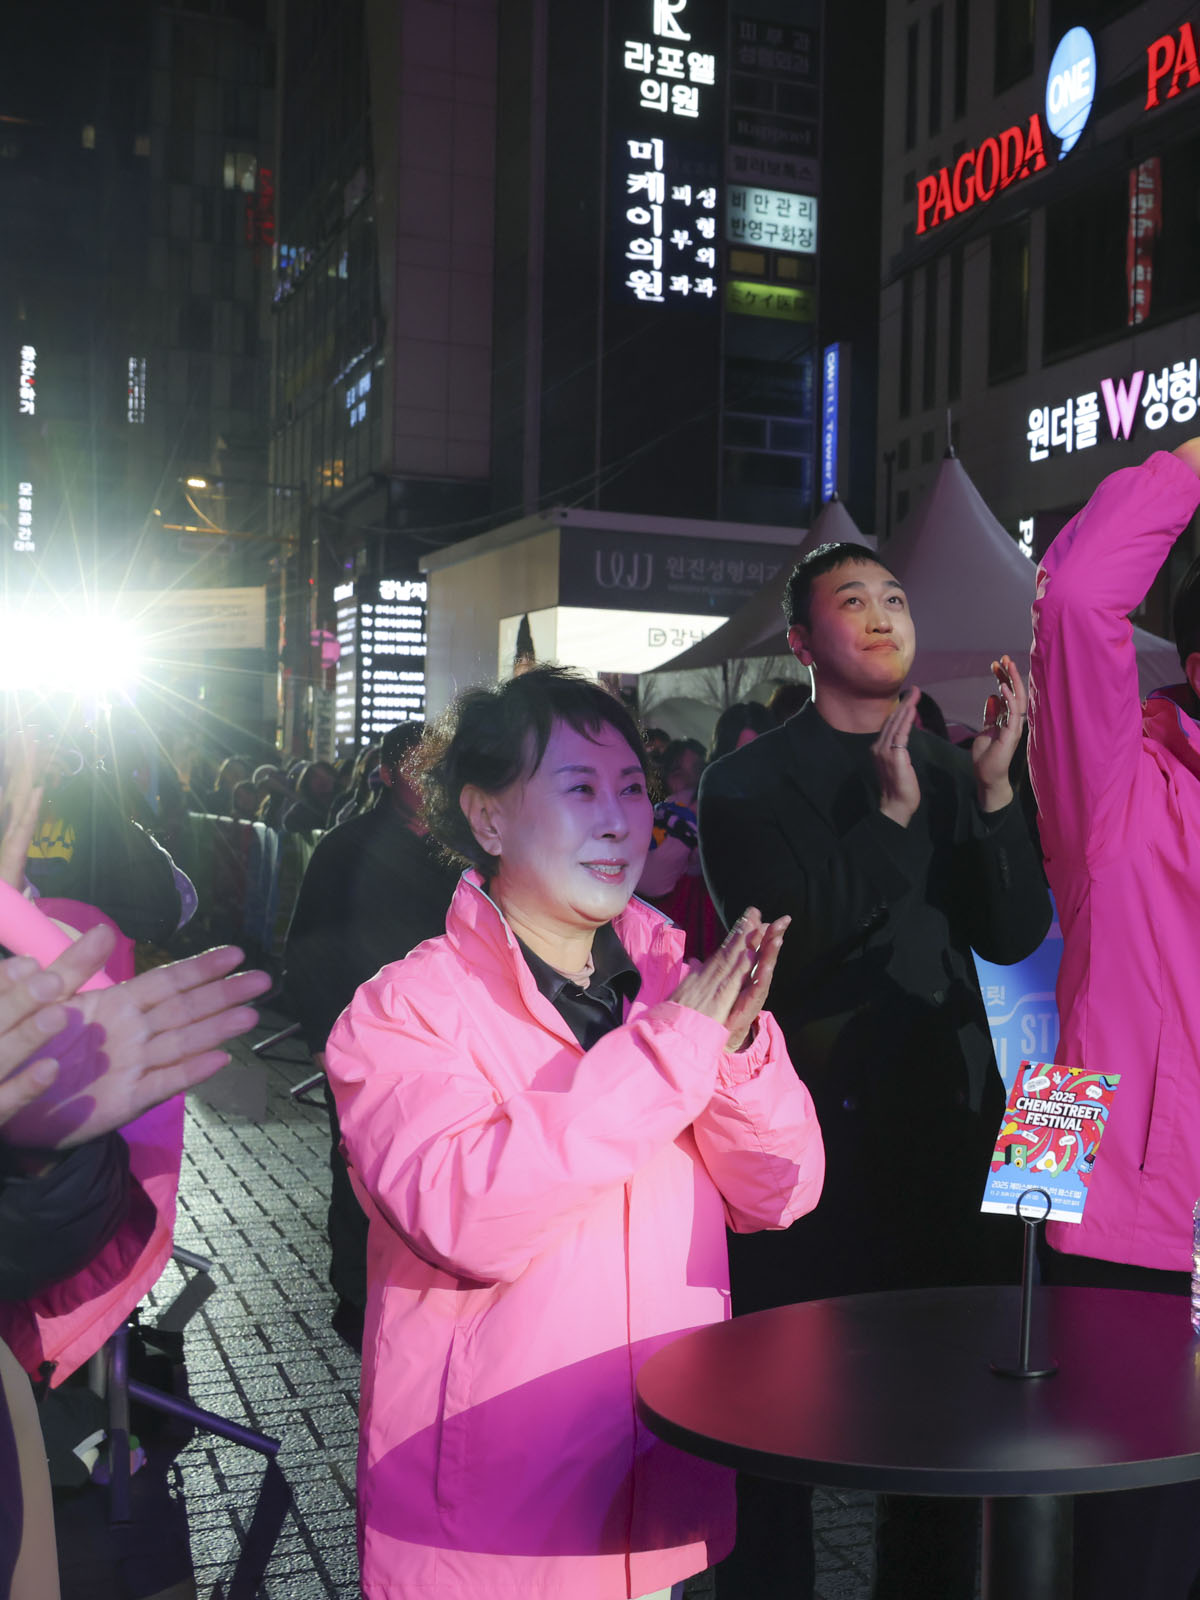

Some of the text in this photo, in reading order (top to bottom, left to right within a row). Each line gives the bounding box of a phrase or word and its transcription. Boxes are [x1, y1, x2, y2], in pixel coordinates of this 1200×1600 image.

[624, 40, 716, 86] 라포엘
[640, 78, 699, 118] 의원
[1049, 56, 1091, 115] ONE
[915, 113, 1047, 235] PAGODA
[625, 138, 665, 302] 미케이의원
[732, 191, 812, 222] 비만관리
[669, 184, 692, 296] 피부과
[693, 187, 717, 299] 성형외과
[731, 218, 813, 248] 반영구화장
[1021, 1013, 1059, 1055] ST
[1016, 1097, 1101, 1121] CHEMISTREET
[1049, 1090, 1077, 1104] 2025
[1024, 1112, 1083, 1132] FESTIVAL
